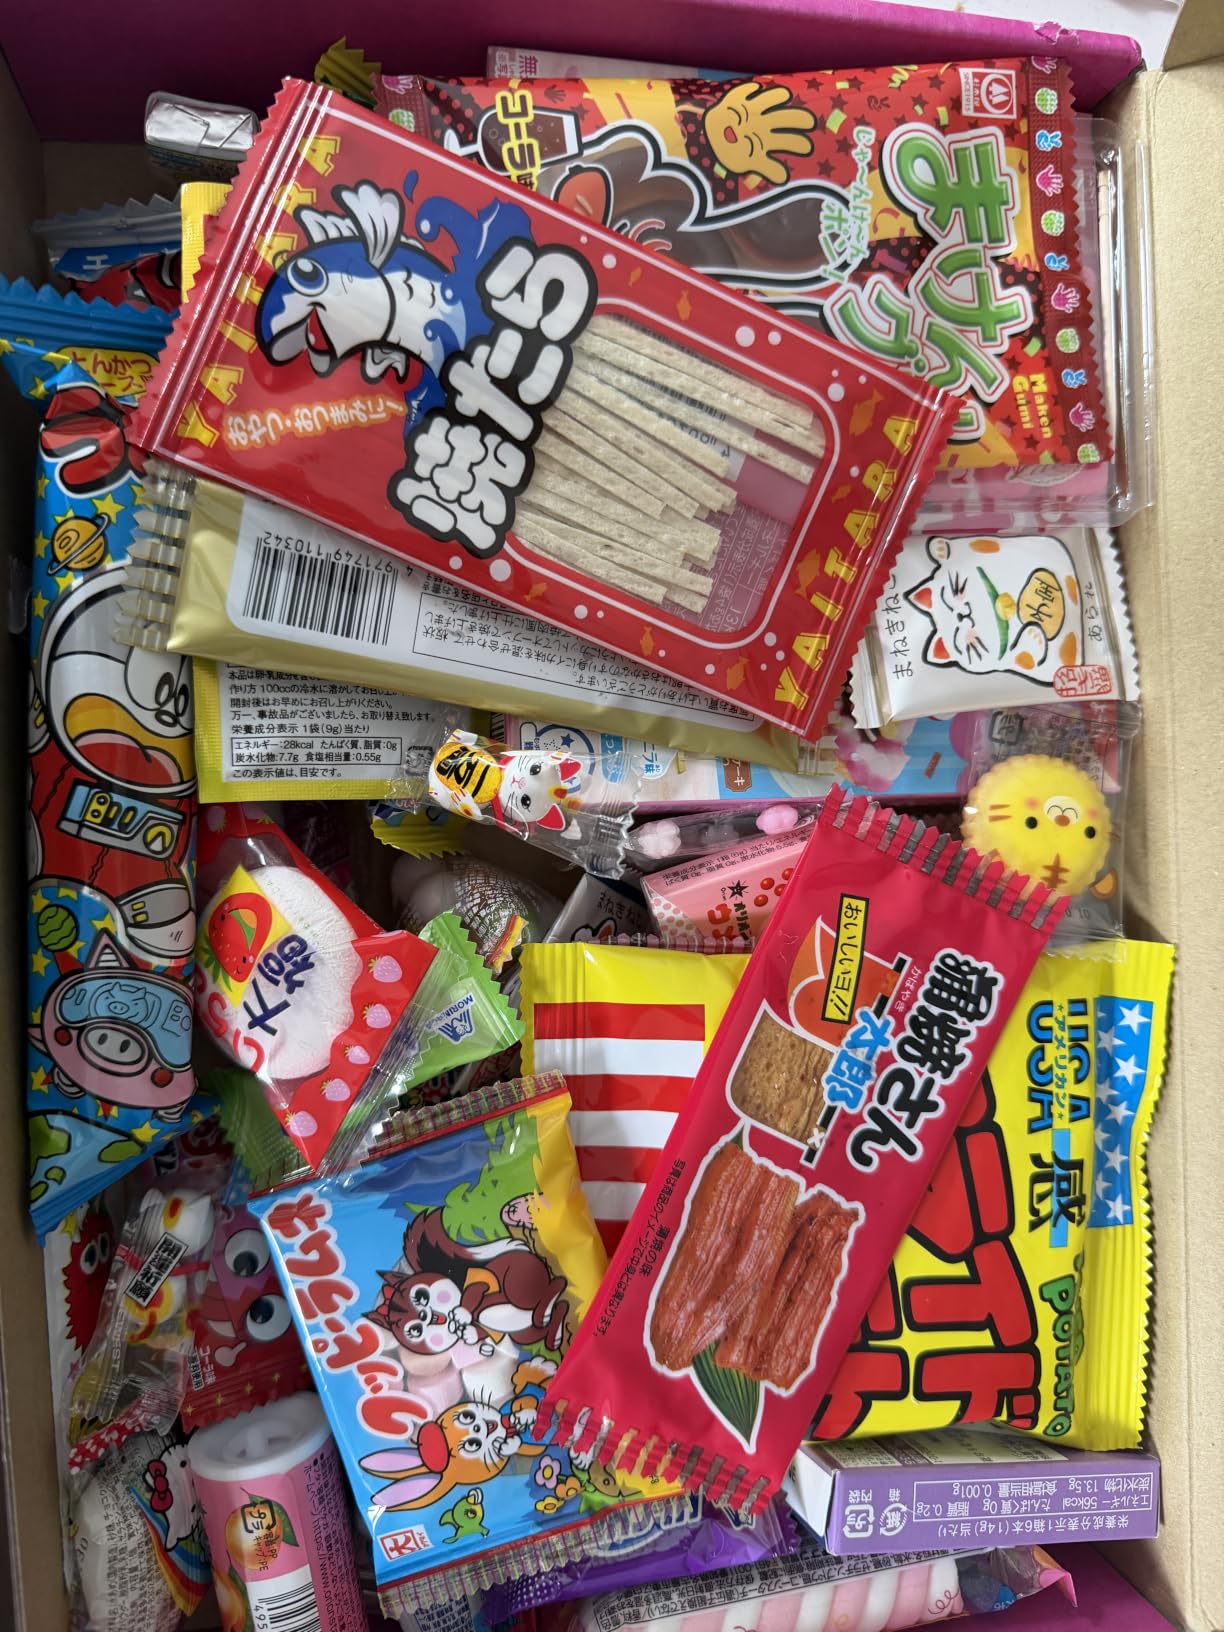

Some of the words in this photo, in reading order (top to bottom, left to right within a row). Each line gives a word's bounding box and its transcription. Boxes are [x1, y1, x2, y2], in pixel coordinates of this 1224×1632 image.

[179, 135, 340, 447] YAITARA
[832, 130, 1026, 432] まけんグ
[392, 240, 594, 552] 焼たら
[1012, 375, 1034, 429] Gumi
[1029, 373, 1052, 438] Maken
[263, 530, 324, 557] 110342
[774, 416, 919, 709] YAITARA
[1084, 581, 1103, 643] あられ
[229, 685, 256, 695] 作り方
[231, 723, 299, 734] 栄養成分表示
[235, 752, 299, 763] 炭水化物:7.7g
[305, 752, 382, 763] 食塩相当量:0.55g
[232, 767, 342, 779] この表示値は、目安です。
[895, 966, 922, 1013] かばやき
[826, 1010, 892, 1110] 太郎
[850, 952, 998, 1168] 蒲焼さん
[1055, 1011, 1069, 1110] アメリカン
[1028, 1152, 1086, 1229] 感
[905, 1082, 1037, 1430] ライド
[266, 1192, 433, 1438] クッピーラムネ
[1039, 1275, 1078, 1438] POTATO
[888, 1487, 902, 1503] 箱
[952, 1481, 993, 1498] 0.001g
[997, 1479, 1058, 1497] 食塩相当量
[1067, 1477, 1099, 1493] 13.5g
[1103, 1476, 1151, 1492] 炭水化物
[916, 1501, 943, 1517] 0.2g
[946, 1501, 971, 1517] 脂質
[982, 1499, 999, 1514] 0g
[1001, 1497, 1052, 1514] たんぱく質
[1062, 1495, 1099, 1511] 56kcal
[1102, 1493, 1150, 1508] エネルギー
[845, 1511, 867, 1529] プラ
